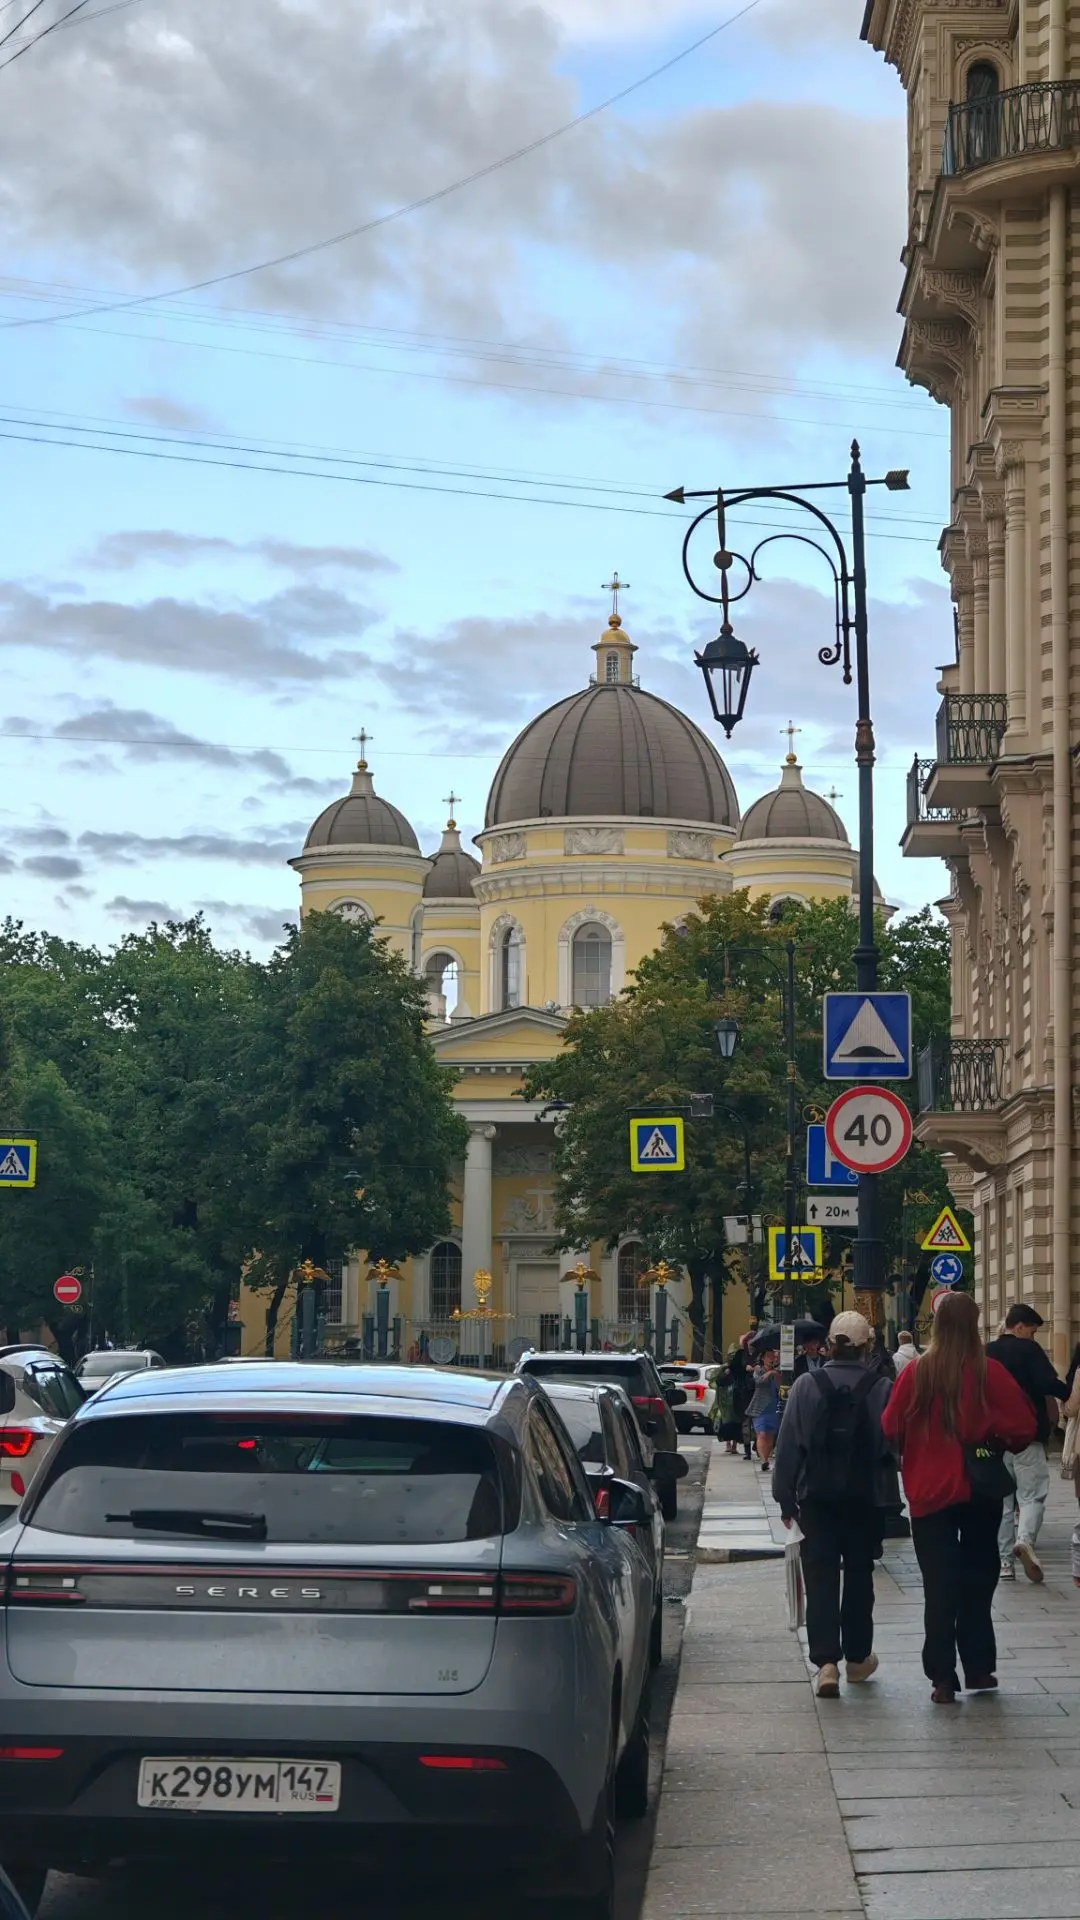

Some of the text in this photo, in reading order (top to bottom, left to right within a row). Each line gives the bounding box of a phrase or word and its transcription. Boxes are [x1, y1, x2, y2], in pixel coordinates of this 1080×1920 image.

[844, 1113, 892, 1147] 40
[175, 1586, 321, 1598] SERES
[282, 1767, 328, 1791] 147
[290, 1792, 315, 1801] RUS
